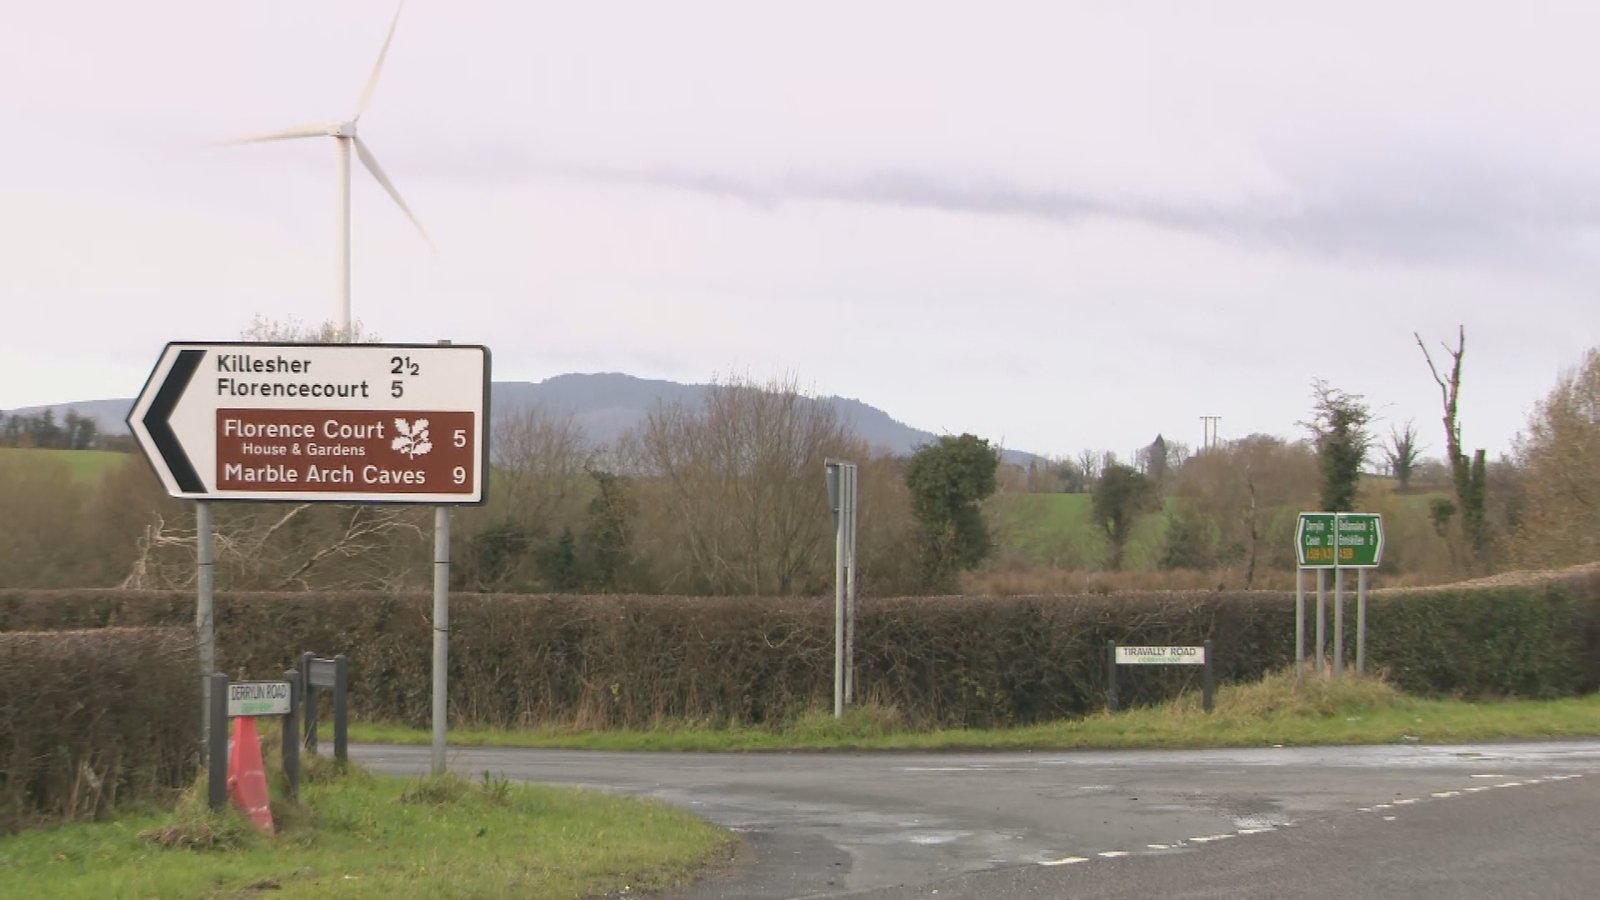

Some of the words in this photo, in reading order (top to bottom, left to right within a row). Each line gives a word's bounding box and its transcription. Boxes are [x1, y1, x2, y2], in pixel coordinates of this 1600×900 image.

[217, 355, 312, 374] Killesher
[217, 379, 370, 398] Florencecourt
[391, 381, 404, 398] 5
[224, 420, 316, 438] Florence
[323, 421, 385, 439] Court
[453, 430, 467, 448] 5
[242, 443, 287, 455] House
[293, 444, 302, 455] &
[306, 444, 366, 456] Gardens
[224, 463, 298, 482] Marble
[306, 465, 354, 483] Arch
[362, 466, 426, 484] Caves
[453, 466, 467, 484] 9
[1124, 648, 1167, 656] TIRAVALLY
[1170, 648, 1197, 656] ROAD
[231, 685, 265, 701] DERRYLIN
[266, 684, 287, 700] ROAD
